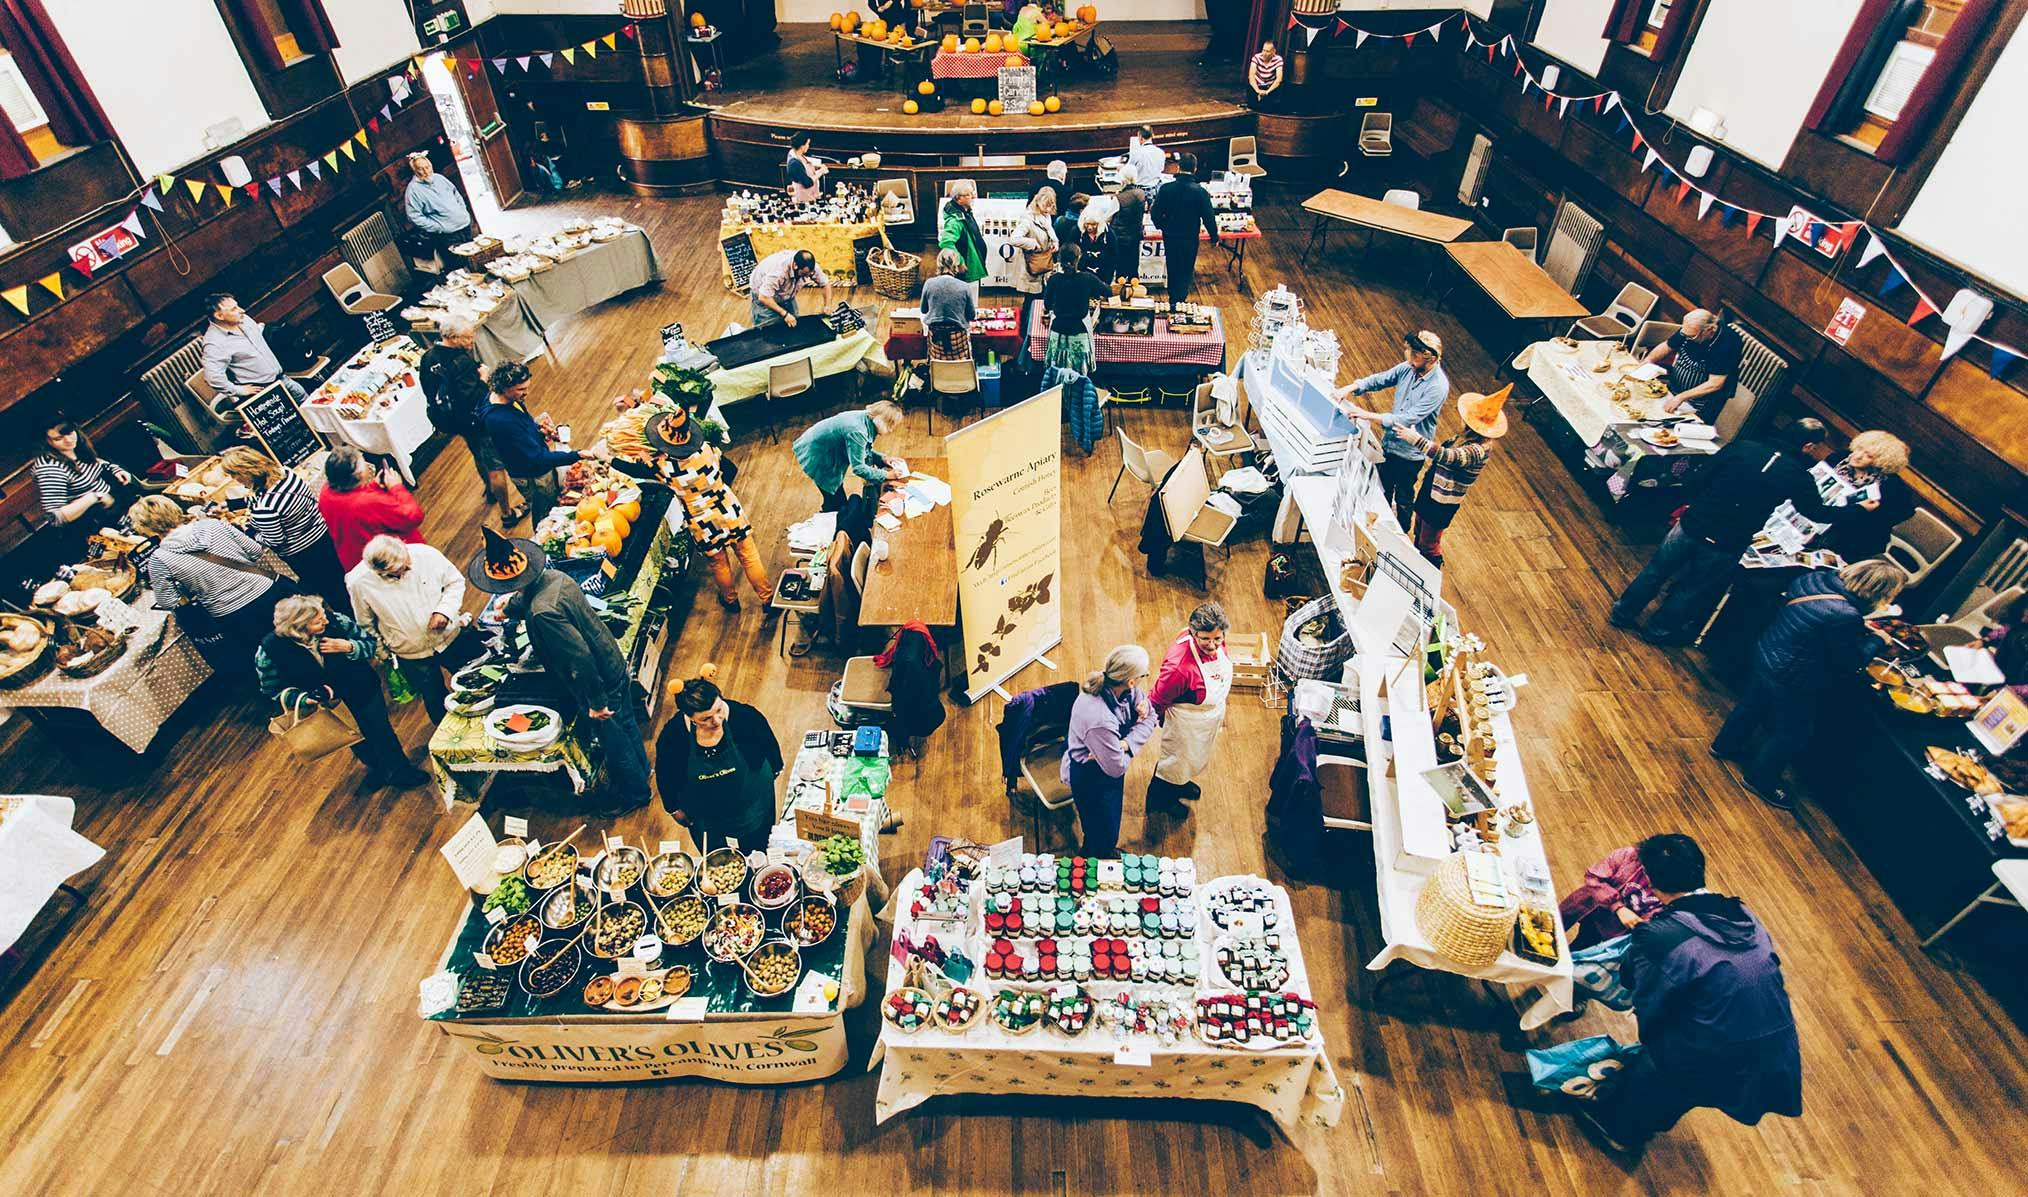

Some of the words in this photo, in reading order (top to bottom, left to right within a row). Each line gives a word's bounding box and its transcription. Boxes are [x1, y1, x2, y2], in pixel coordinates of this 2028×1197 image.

[994, 275, 1009, 283] Tel:
[246, 394, 281, 418] Homemade
[253, 417, 269, 429] Hot
[267, 402, 286, 419] Soup!
[973, 468, 1025, 501] Rosewarne
[1026, 452, 1057, 474] Apiary
[1012, 476, 1038, 496] Cornish
[1038, 470, 1057, 484] Honey
[508, 1044, 656, 1062] OLIVER'S
[663, 1040, 785, 1061] OLIVES
[492, 1059, 548, 1070] Freshly
[551, 1064, 622, 1073] prepared
[644, 1057, 744, 1072] Perranporth,
[746, 1058, 817, 1071] Cornwall
